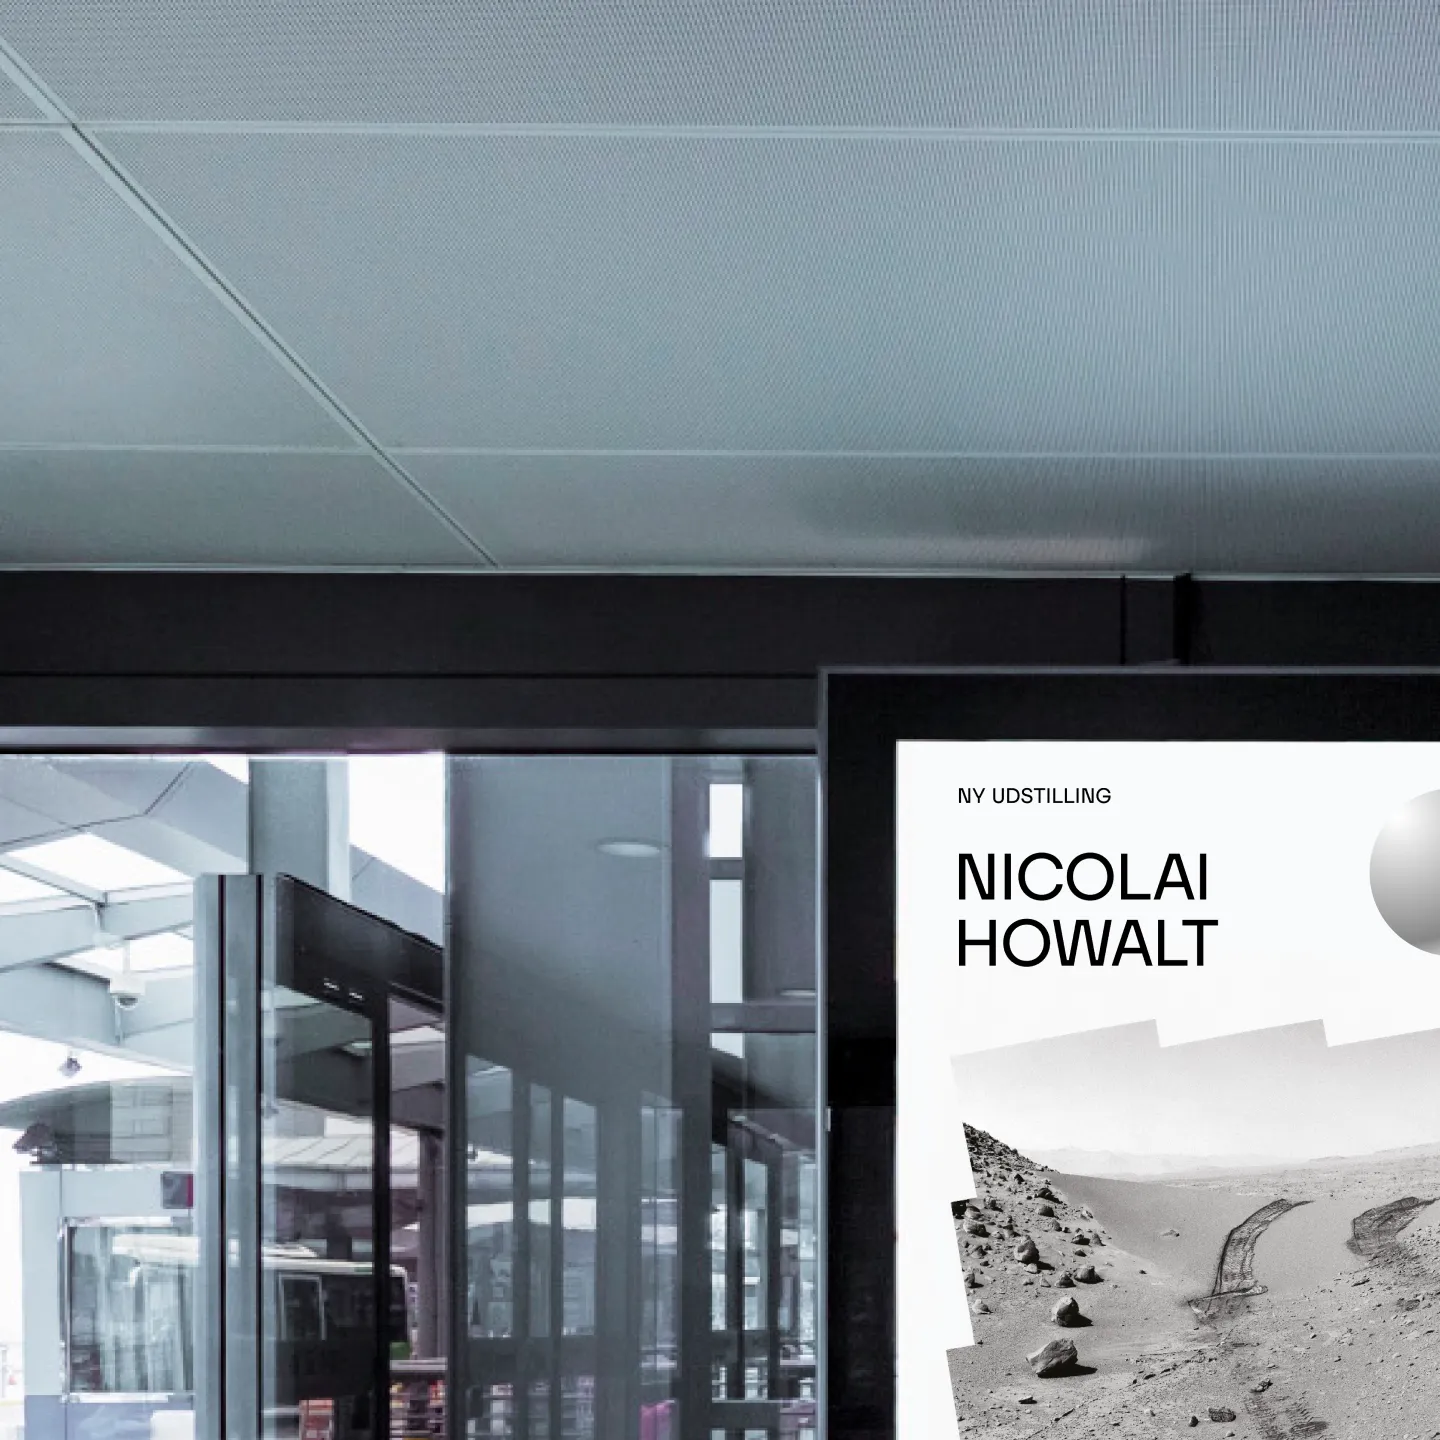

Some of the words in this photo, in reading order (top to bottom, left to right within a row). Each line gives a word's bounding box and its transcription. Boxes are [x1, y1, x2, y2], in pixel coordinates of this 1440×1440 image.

[959, 788, 985, 803] NY
[993, 788, 1111, 803] UDSTILLING
[959, 853, 1206, 901] NICOLAI
[959, 919, 1218, 967] HOWALT
